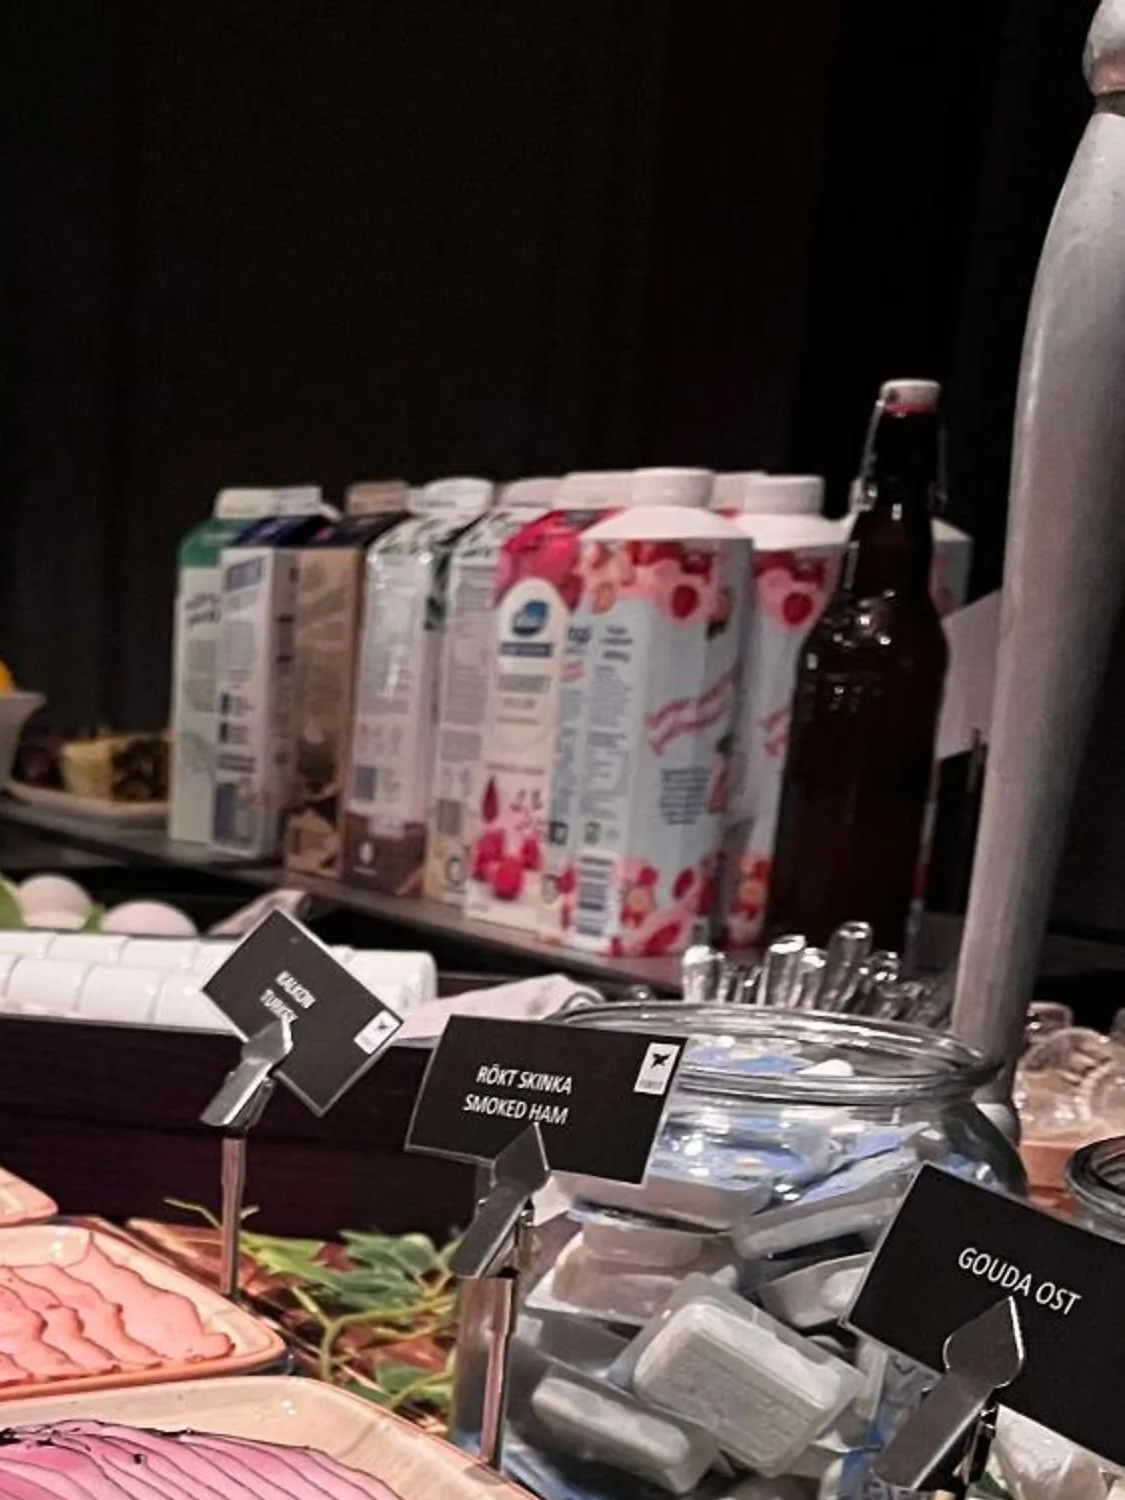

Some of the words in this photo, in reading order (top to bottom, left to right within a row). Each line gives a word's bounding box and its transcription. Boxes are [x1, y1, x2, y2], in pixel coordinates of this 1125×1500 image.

[476, 1064, 520, 1087] RÖKT
[519, 1072, 572, 1095] SKINKA
[463, 1094, 526, 1119] SMOKED
[528, 1103, 569, 1125] HAM
[958, 1247, 1032, 1297] GOUDA
[1035, 1281, 1082, 1315] OST
